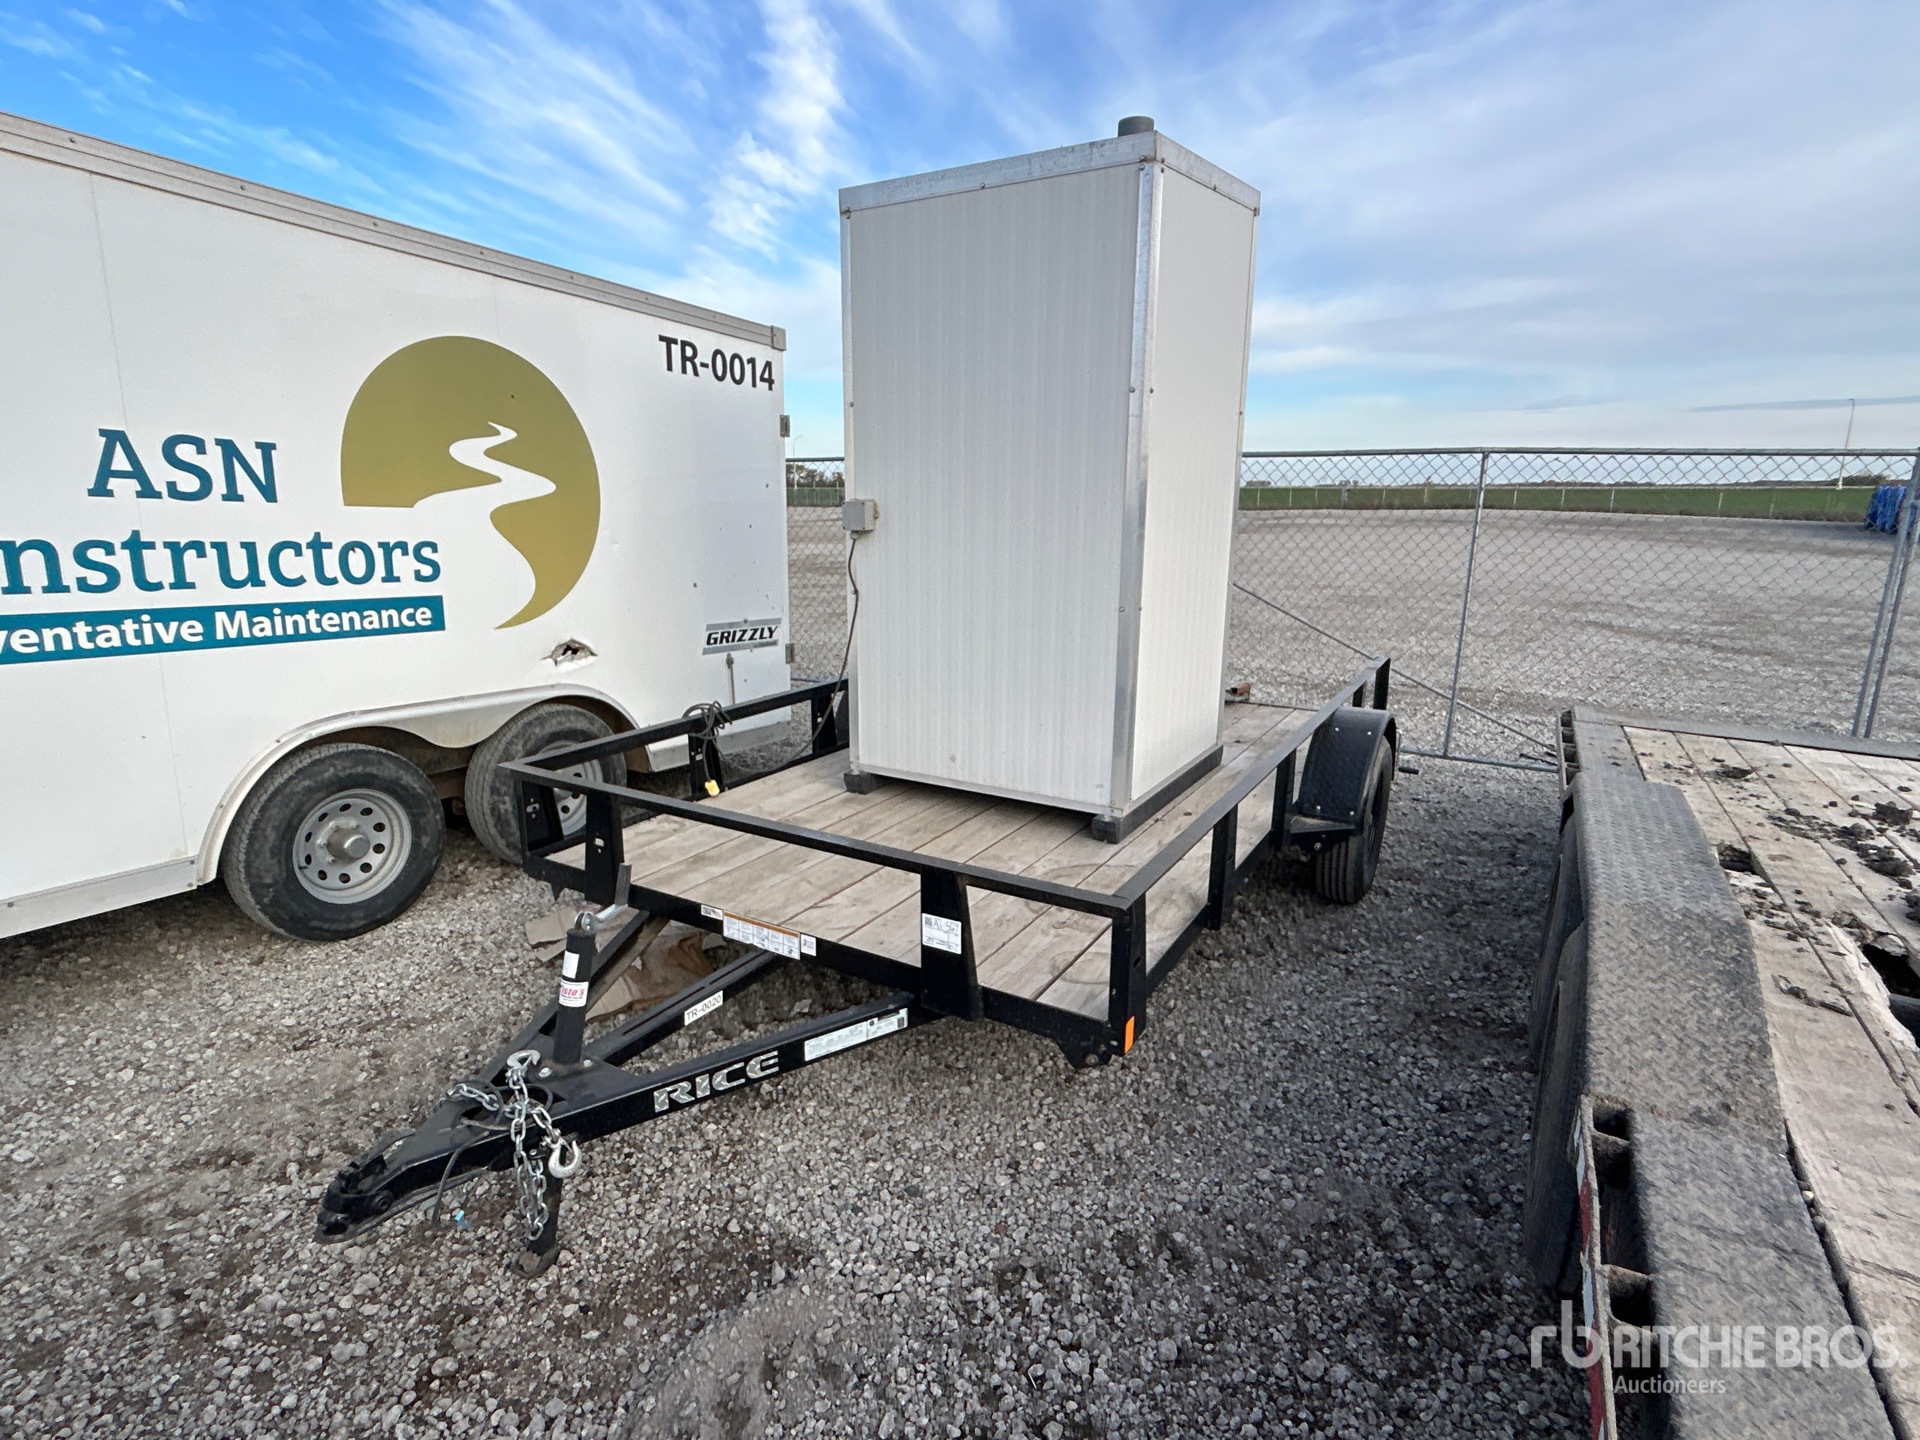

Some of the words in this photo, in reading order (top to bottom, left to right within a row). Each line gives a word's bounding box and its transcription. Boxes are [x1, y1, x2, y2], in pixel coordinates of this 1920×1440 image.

[658, 334, 775, 391] TR-0014
[87, 428, 278, 503] ASN
[214, 607, 432, 640] Maintenance
[706, 625, 778, 646] GRIZZLY
[653, 1050, 779, 1113] RICE
